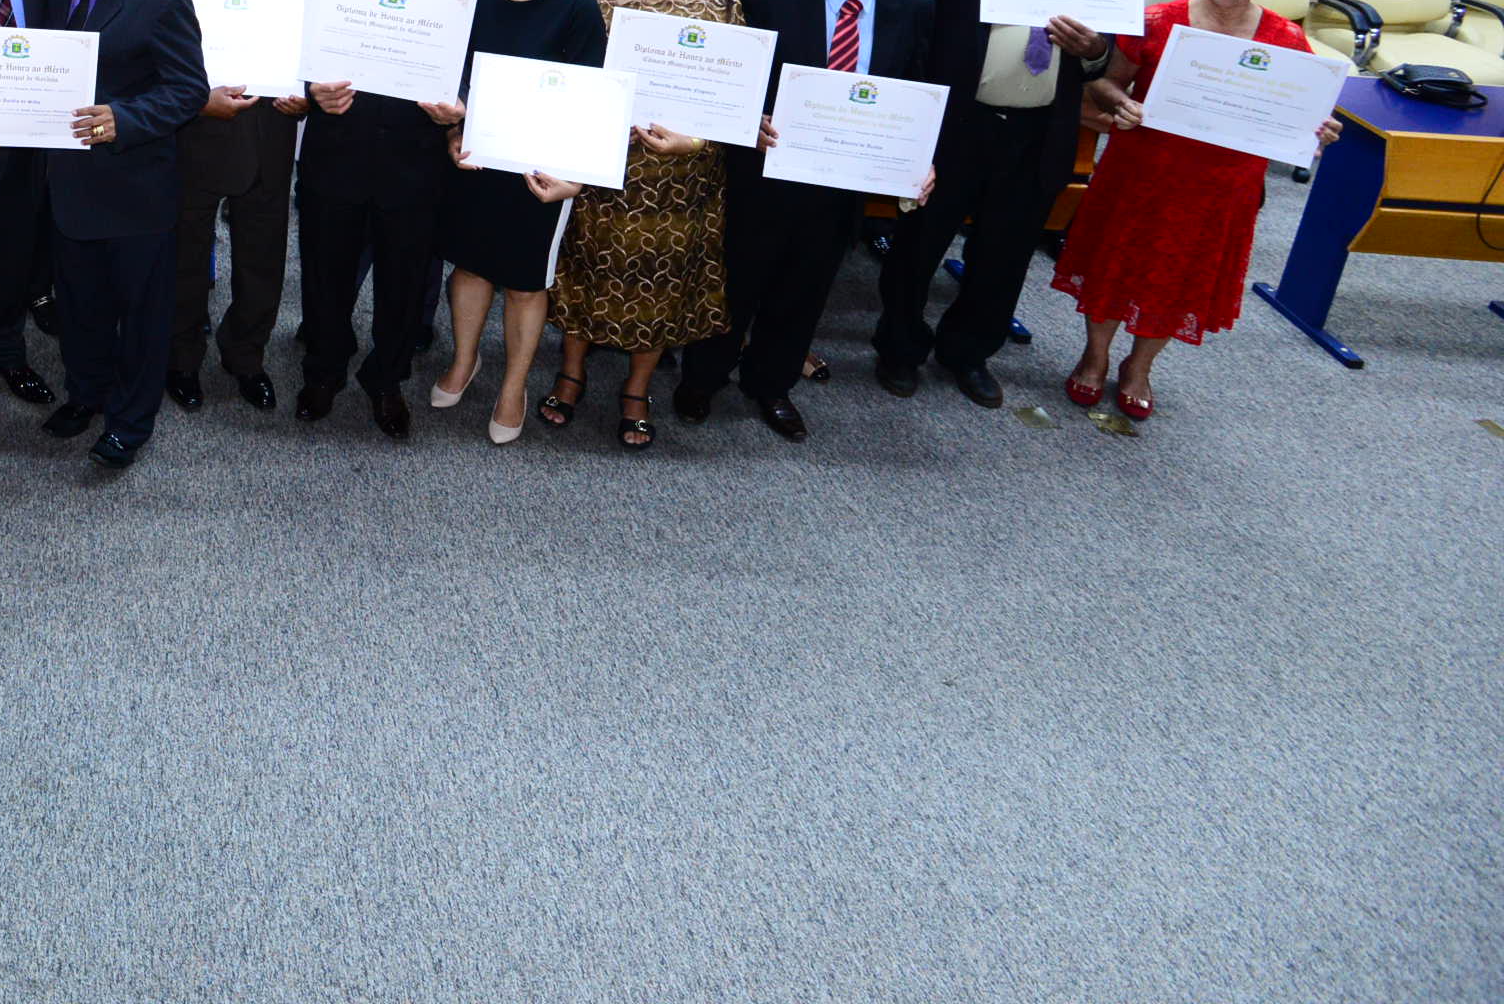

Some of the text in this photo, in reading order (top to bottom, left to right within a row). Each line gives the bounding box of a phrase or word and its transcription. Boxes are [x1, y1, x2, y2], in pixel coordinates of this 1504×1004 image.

[336, 4, 367, 17] Diploma
[381, 12, 404, 23] Honra
[418, 17, 443, 29] Mérito
[634, 44, 665, 56] Diploma
[680, 51, 702, 62] Honra
[717, 58, 743, 68] Mérito
[6, 63, 30, 72] Honra
[44, 66, 69, 74] Mérito
